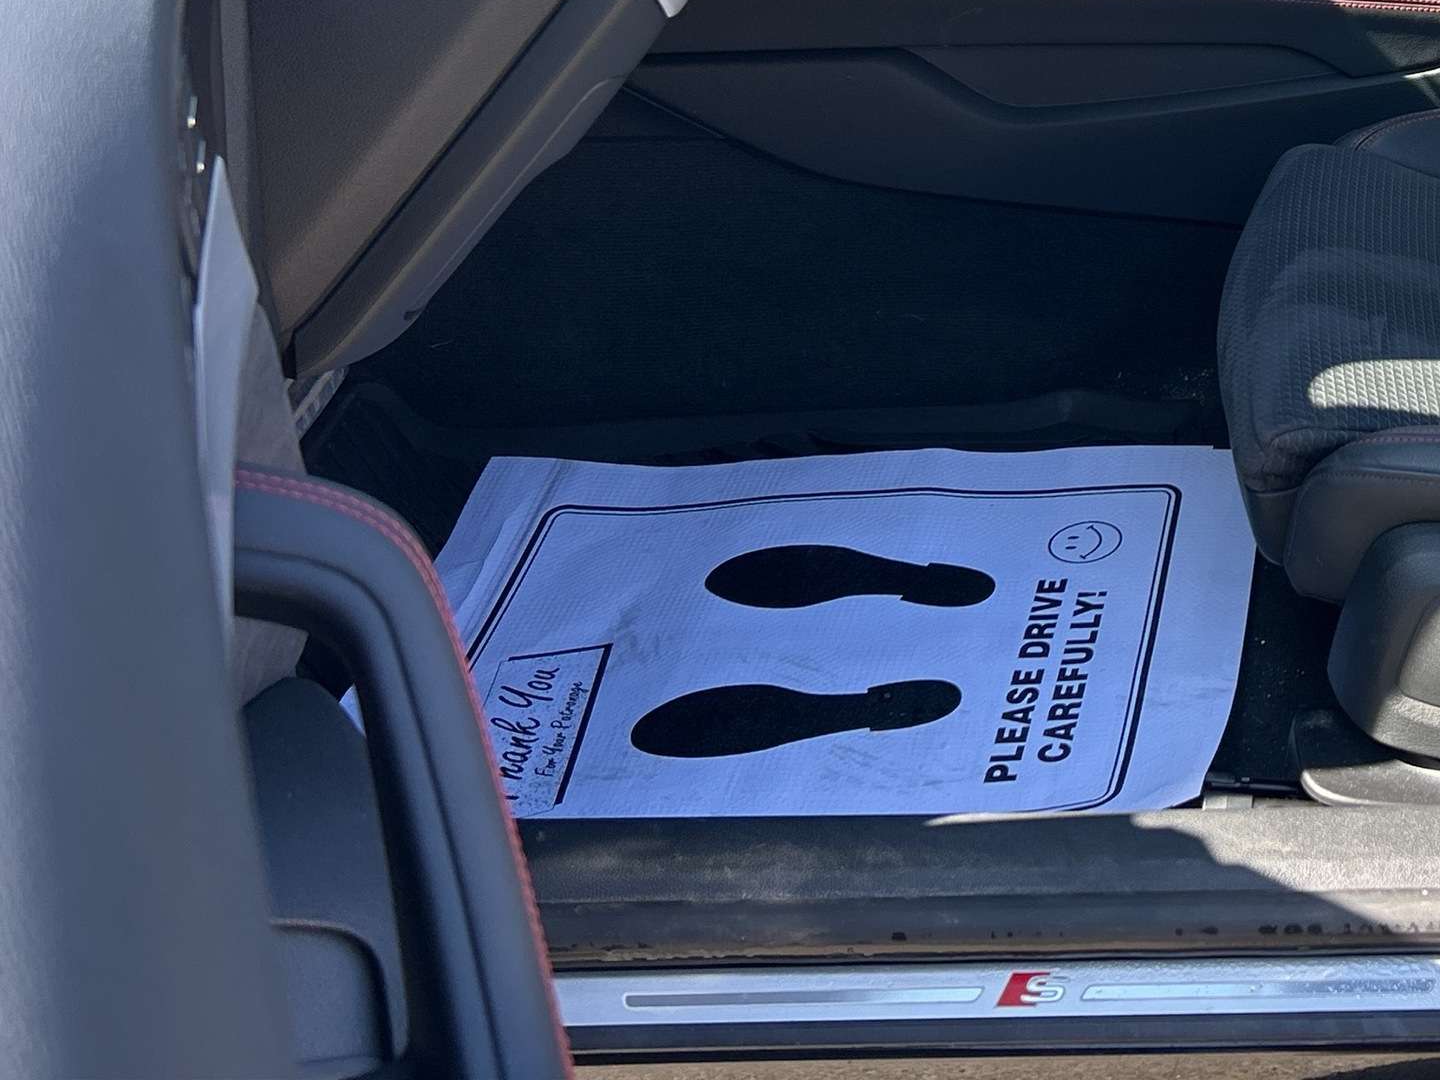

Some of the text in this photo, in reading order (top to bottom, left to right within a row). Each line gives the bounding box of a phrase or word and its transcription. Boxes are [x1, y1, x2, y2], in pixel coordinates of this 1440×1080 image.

[498, 667, 560, 709] You
[535, 680, 590, 777] For Your Patronage
[983, 578, 1068, 784] PLEASE DRIVE
[1037, 591, 1108, 763] CAREFULLY!
